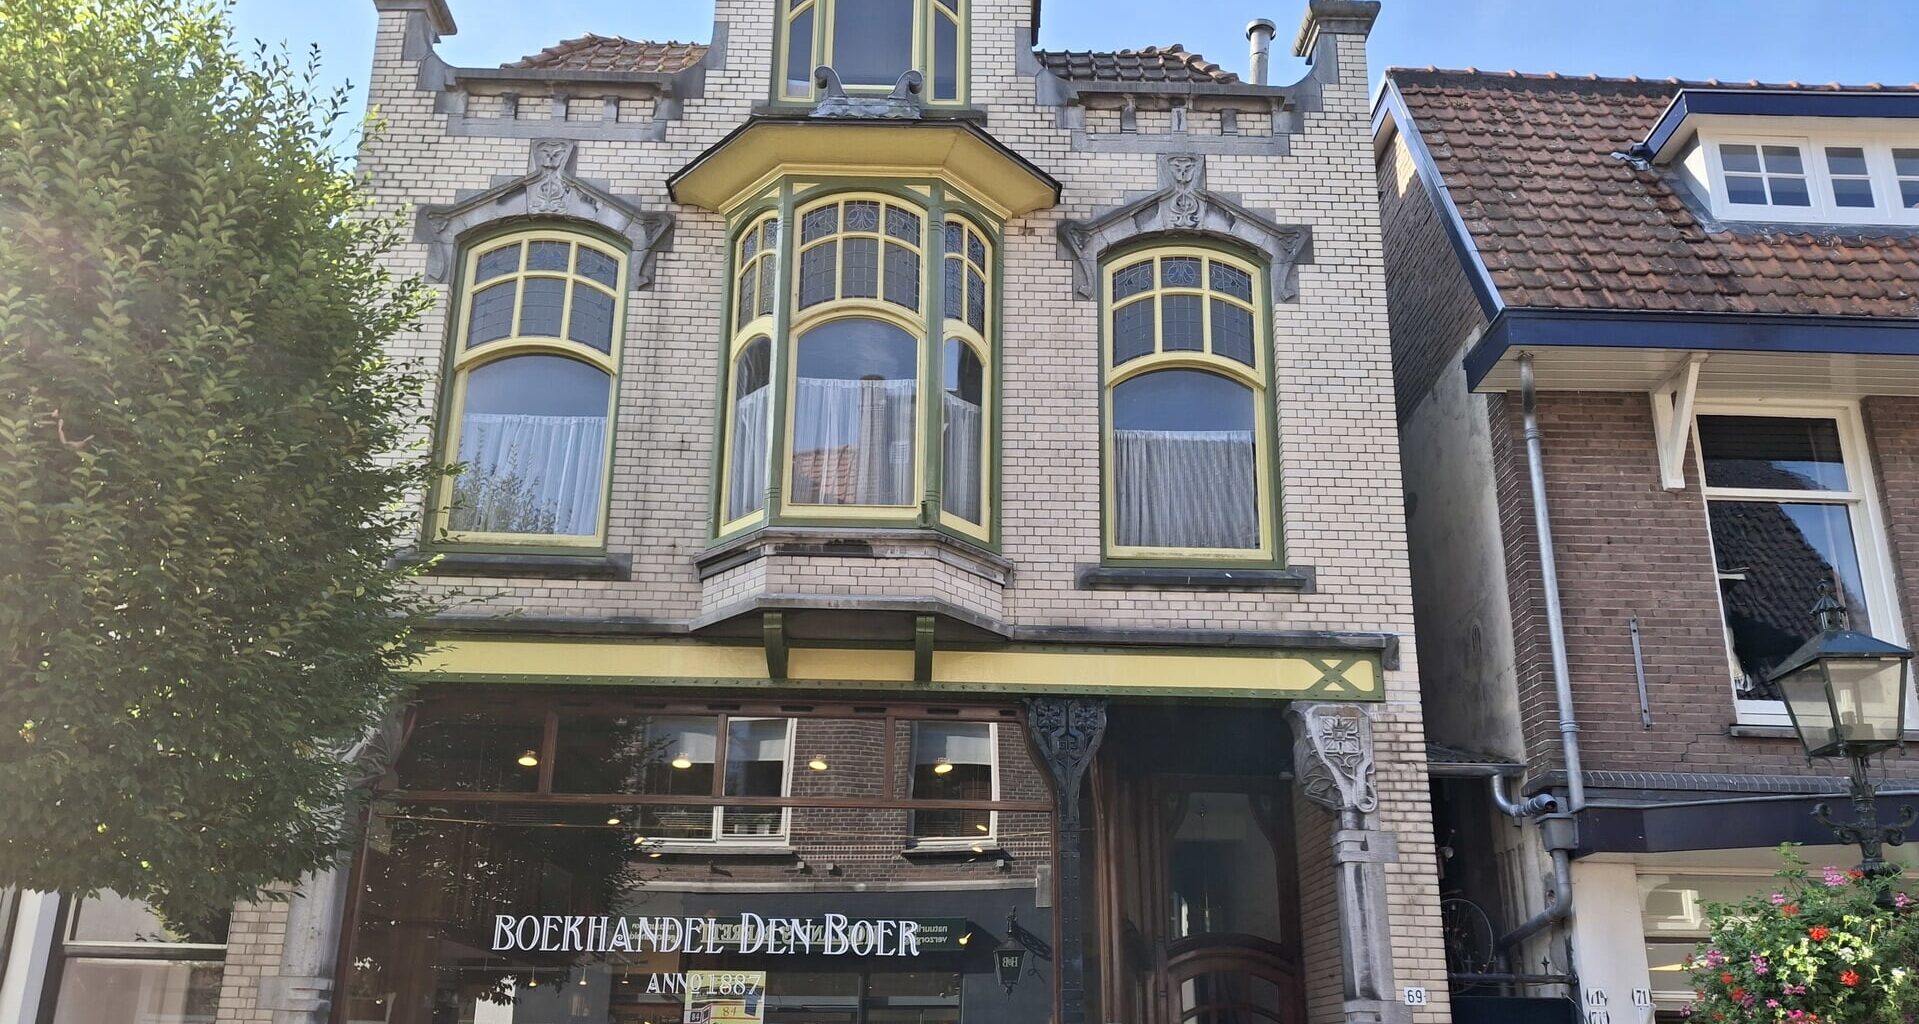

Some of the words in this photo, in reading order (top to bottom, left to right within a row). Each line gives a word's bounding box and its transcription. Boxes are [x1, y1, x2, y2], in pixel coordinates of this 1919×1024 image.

[491, 914, 724, 954] BOEKHANDEL
[706, 973, 761, 995] 1887
[1407, 989, 1423, 1003] 69
[1636, 990, 1647, 1004] 71
